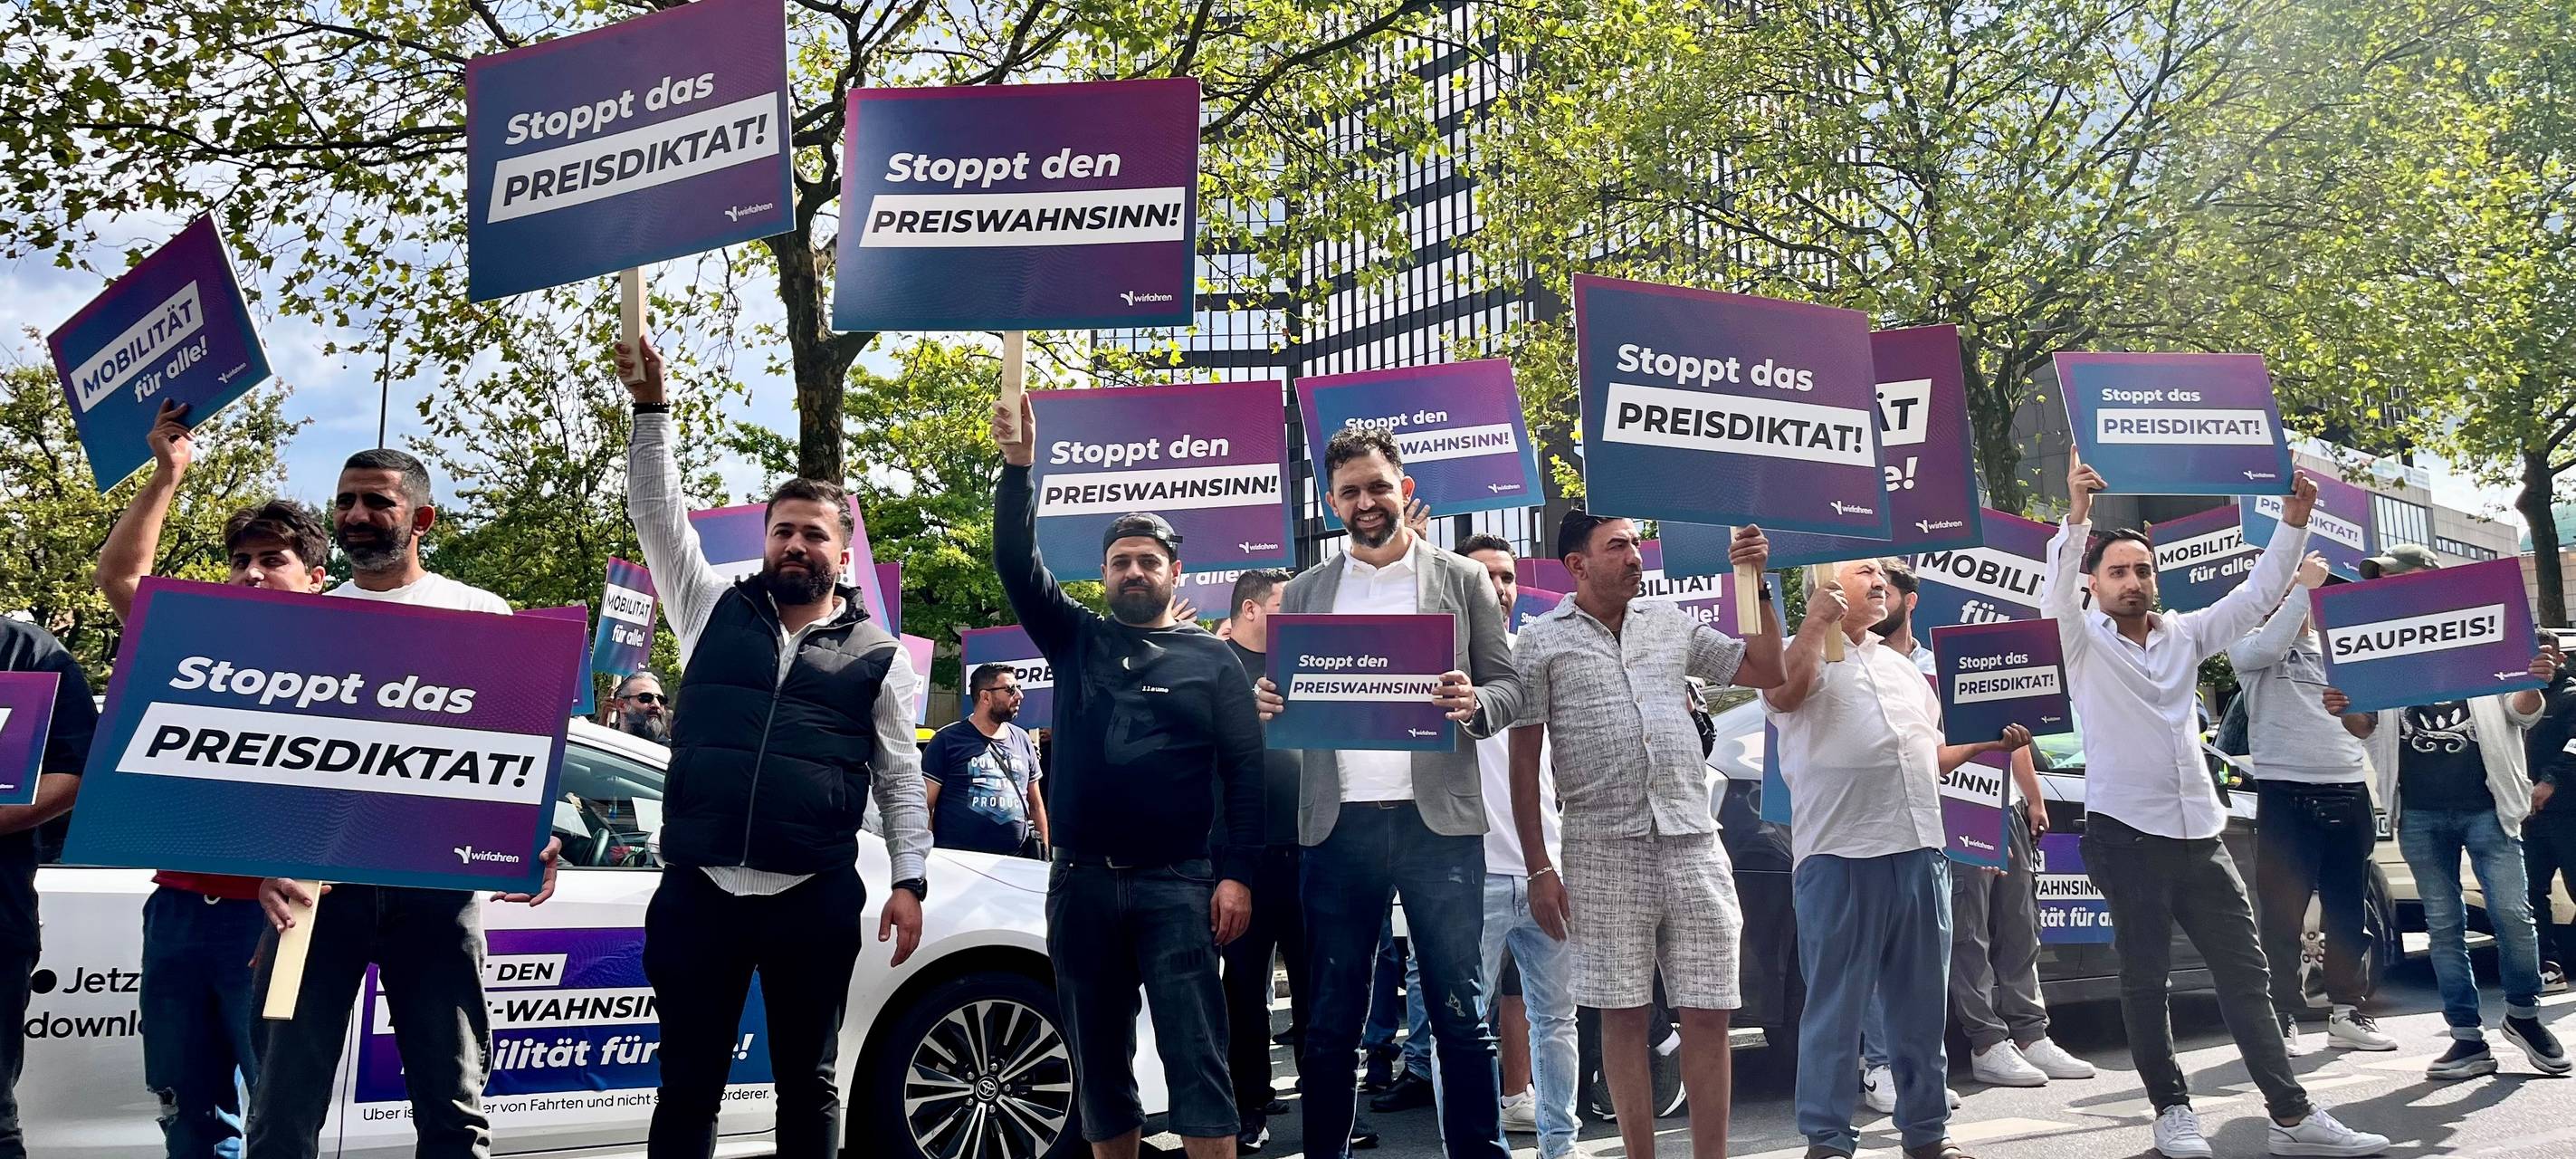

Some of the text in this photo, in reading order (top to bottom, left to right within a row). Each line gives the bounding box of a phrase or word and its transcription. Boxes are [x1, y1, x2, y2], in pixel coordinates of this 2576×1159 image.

[505, 72, 714, 145] Stoppt das
[503, 113, 768, 206] PREISDIKTAT!
[884, 148, 1121, 188] Stoppt den
[737, 202, 773, 217] wirfahren
[872, 203, 1181, 233] PREISWAHNSINN!
[1134, 292, 1172, 302] wirfahren
[82, 299, 193, 398] MOBILITÄT
[134, 335, 208, 403] für alle!
[1617, 343, 1814, 392] Stoppt das
[2101, 388, 2201, 404] Stoppt das
[1345, 410, 1447, 432] Stoppt den
[1617, 401, 1863, 454] PREISDIKTAT!
[2104, 418, 2261, 436] PREISDIKTAT!
[1050, 435, 1229, 467] Stoppt den
[1045, 475, 1277, 505] PREISWAHNSINN!
[1928, 520, 1963, 530] wirfahren
[2189, 563, 2217, 584] für
[606, 594, 650, 617] MOBILITÄT
[1960, 600, 2010, 624] für
[612, 624, 645, 647] für alle!
[2335, 616, 2495, 656] SAUPREIS!
[1298, 655, 1388, 670] Stoppt den
[1959, 652, 2028, 670] Stoppt das
[168, 656, 476, 714] Stoppt das
[1959, 674, 2054, 695] PREISDIKTAT!
[145, 724, 535, 788] PREISDIKTAT!
[471, 850, 520, 864] wirfahren
[2070, 907, 2094, 927] für
[497, 963, 555, 982] DEN
[24, 1010, 144, 1039] downl
[600, 1035, 661, 1066] für
[363, 1107, 401, 1120] Uber
[501, 1102, 527, 1113] von
[530, 1097, 584, 1111] Fahrten
[587, 1095, 614, 1108] und
[617, 1093, 650, 1106] nicht
